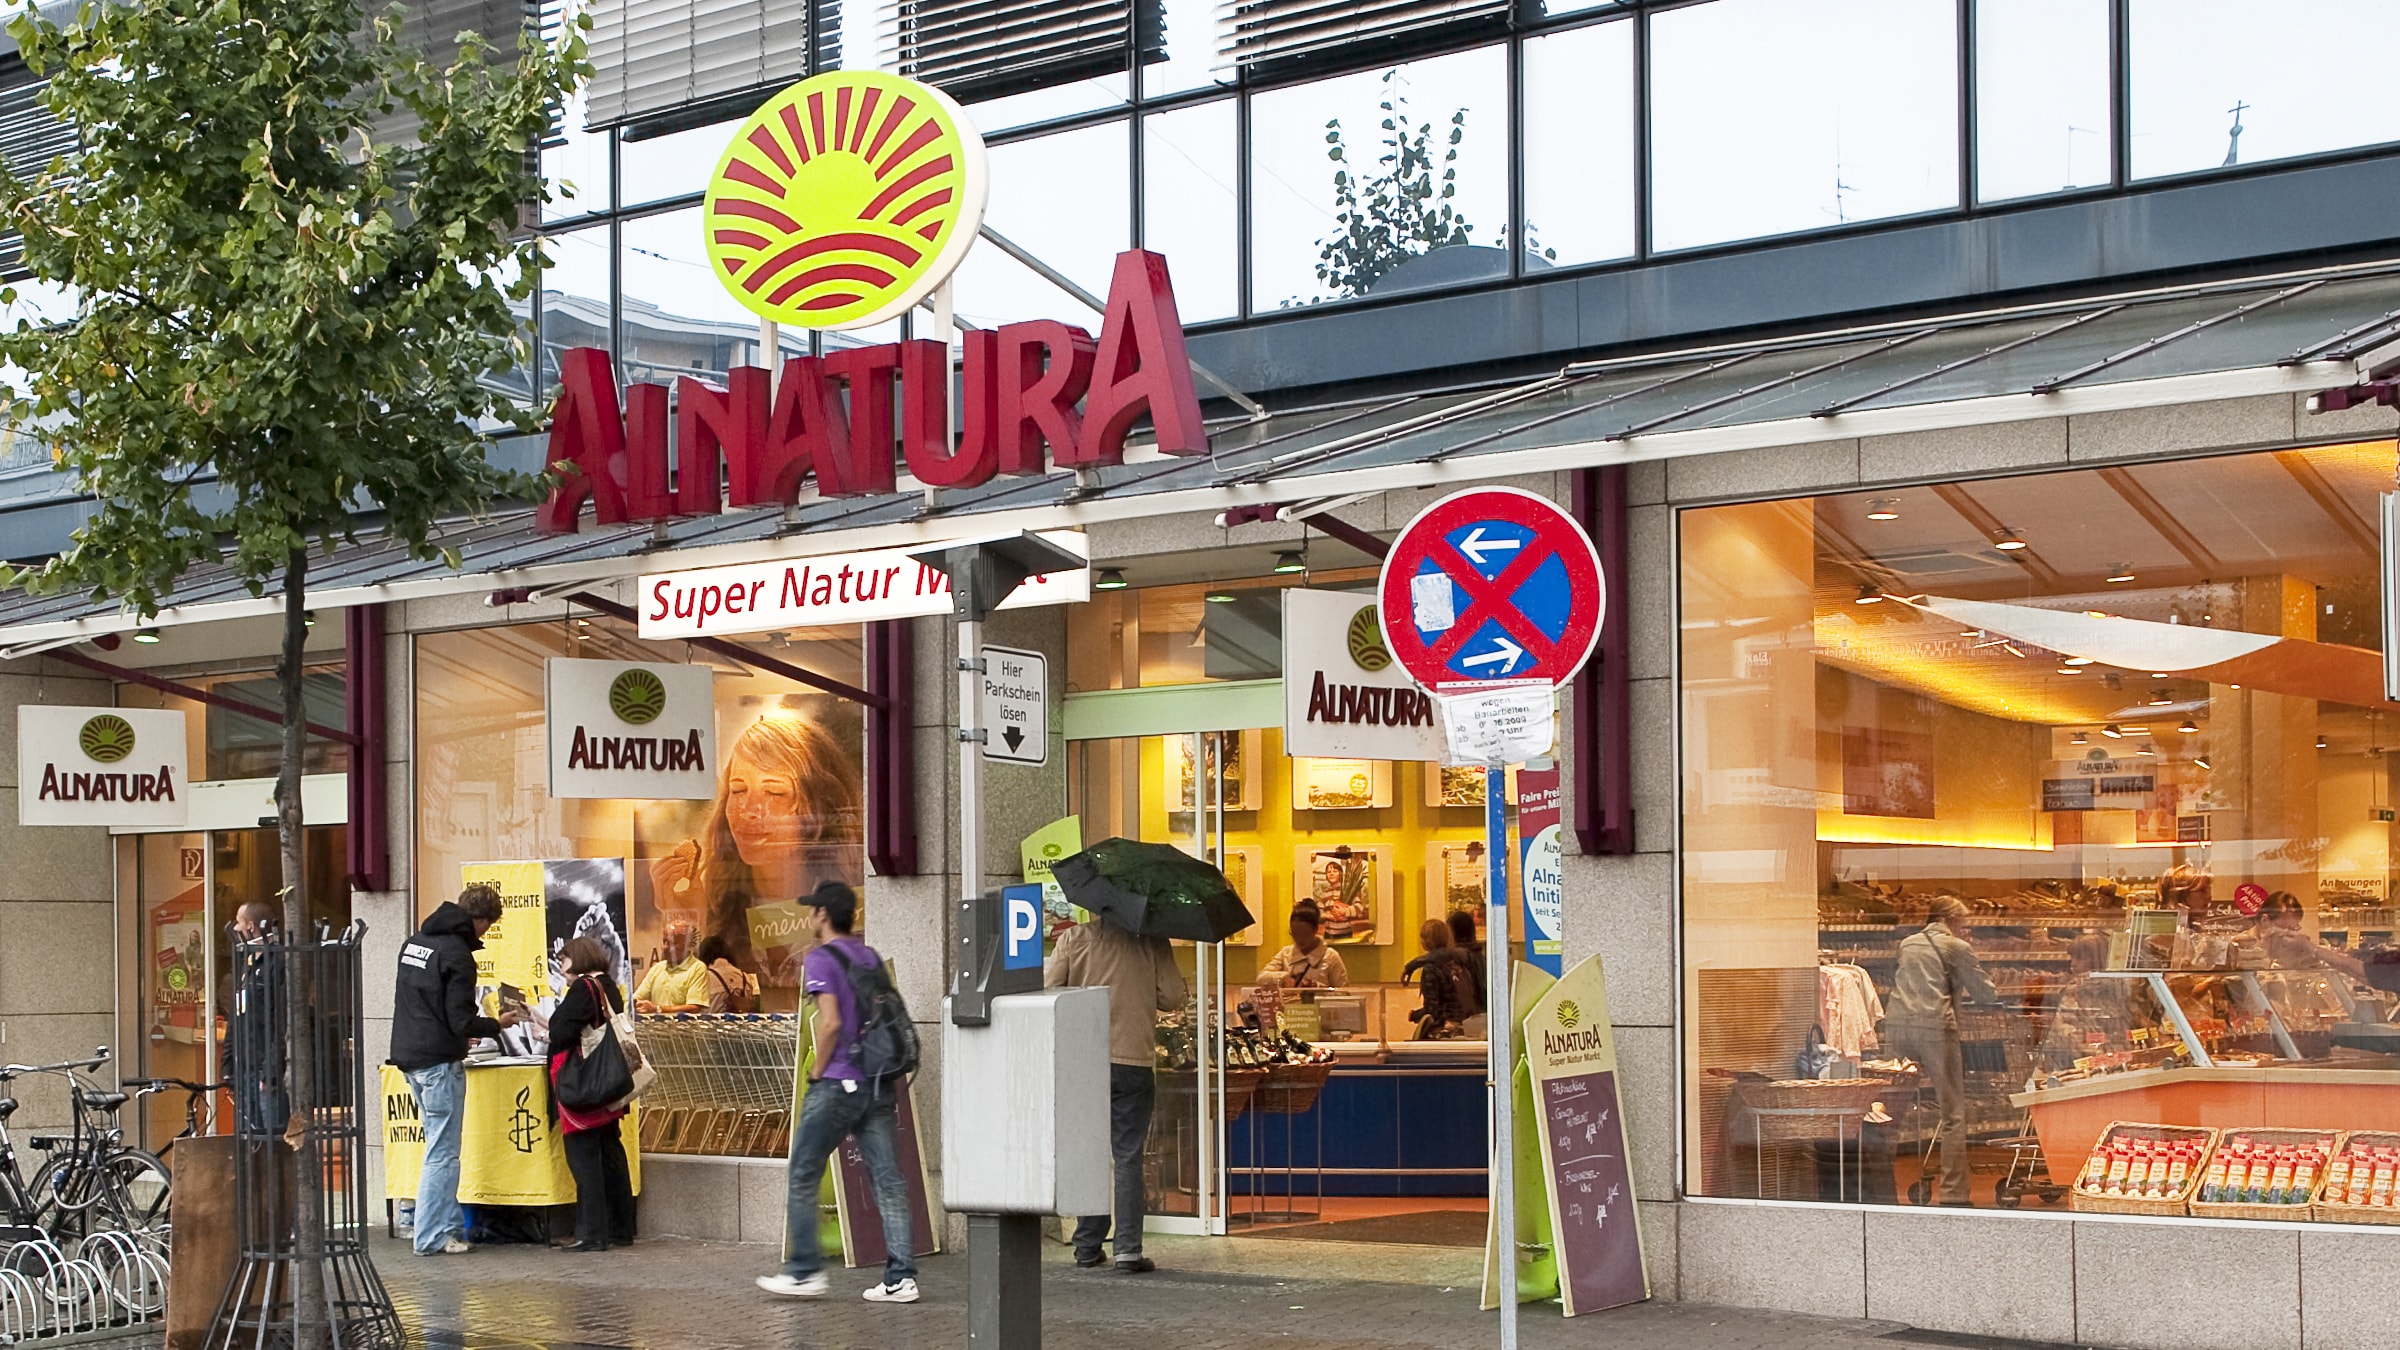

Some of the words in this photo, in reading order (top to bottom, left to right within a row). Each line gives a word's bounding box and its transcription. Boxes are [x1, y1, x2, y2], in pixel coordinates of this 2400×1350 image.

[535, 249, 1209, 534] ALNATURA
[650, 580, 765, 628] Super
[780, 564, 900, 608] Natur
[1001, 660, 1023, 678] Hier
[985, 680, 1041, 703] Parkschein
[1307, 670, 1434, 726] ALNATURA
[1481, 697, 1511, 707] wegen
[1000, 703, 1027, 723] lösen
[1474, 706, 1530, 719] Bauarbeiten
[1506, 726, 1523, 734] Uhr
[568, 725, 704, 771] ALNATURA
[39, 763, 175, 801] ALNATURA
[1521, 792, 1542, 804] Faire
[2320, 878, 2382, 888] Angungen
[1535, 907, 1549, 917] seit
[1008, 899, 1038, 957] P
[1544, 1024, 1602, 1056] ALNATURA
[1549, 1057, 1566, 1067] Super
[1567, 1054, 1582, 1064] Natur
[1584, 1051, 1601, 1062] Markt
